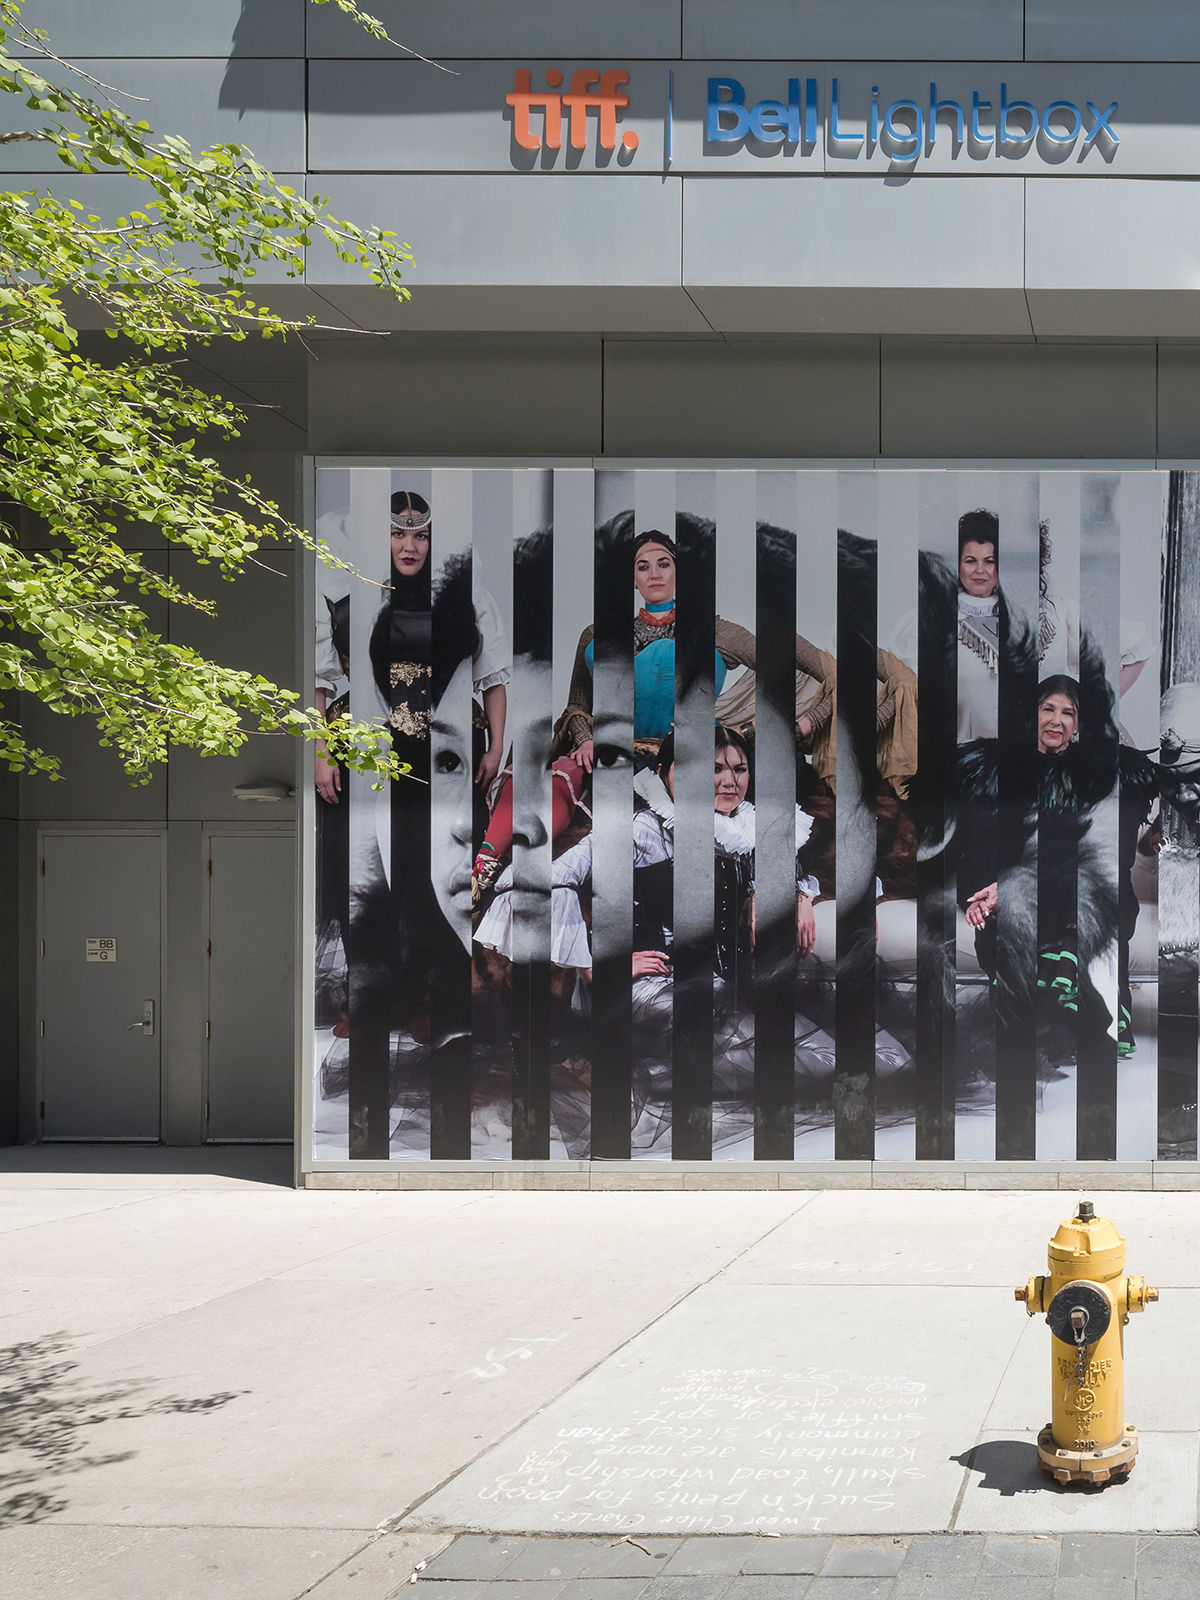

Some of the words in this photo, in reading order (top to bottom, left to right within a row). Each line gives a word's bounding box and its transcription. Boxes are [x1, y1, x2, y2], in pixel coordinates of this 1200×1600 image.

[505, 67, 640, 151] tiff.
[705, 77, 818, 144] Bell
[831, 81, 1121, 162] Lightbox
[99, 939, 114, 949] BB
[99, 951, 108, 960] G
[732, 1410, 764, 1422] or
[781, 1411, 926, 1429] sniffles
[556, 1426, 630, 1445] than
[643, 1426, 742, 1443] sited
[753, 1421, 921, 1445] commonly
[678, 1444, 737, 1460] are
[758, 1445, 918, 1463] kannibals
[727, 1467, 809, 1487] toad
[573, 1489, 633, 1509] for
[653, 1488, 750, 1510] penis
[660, 1514, 735, 1529] Chloe
